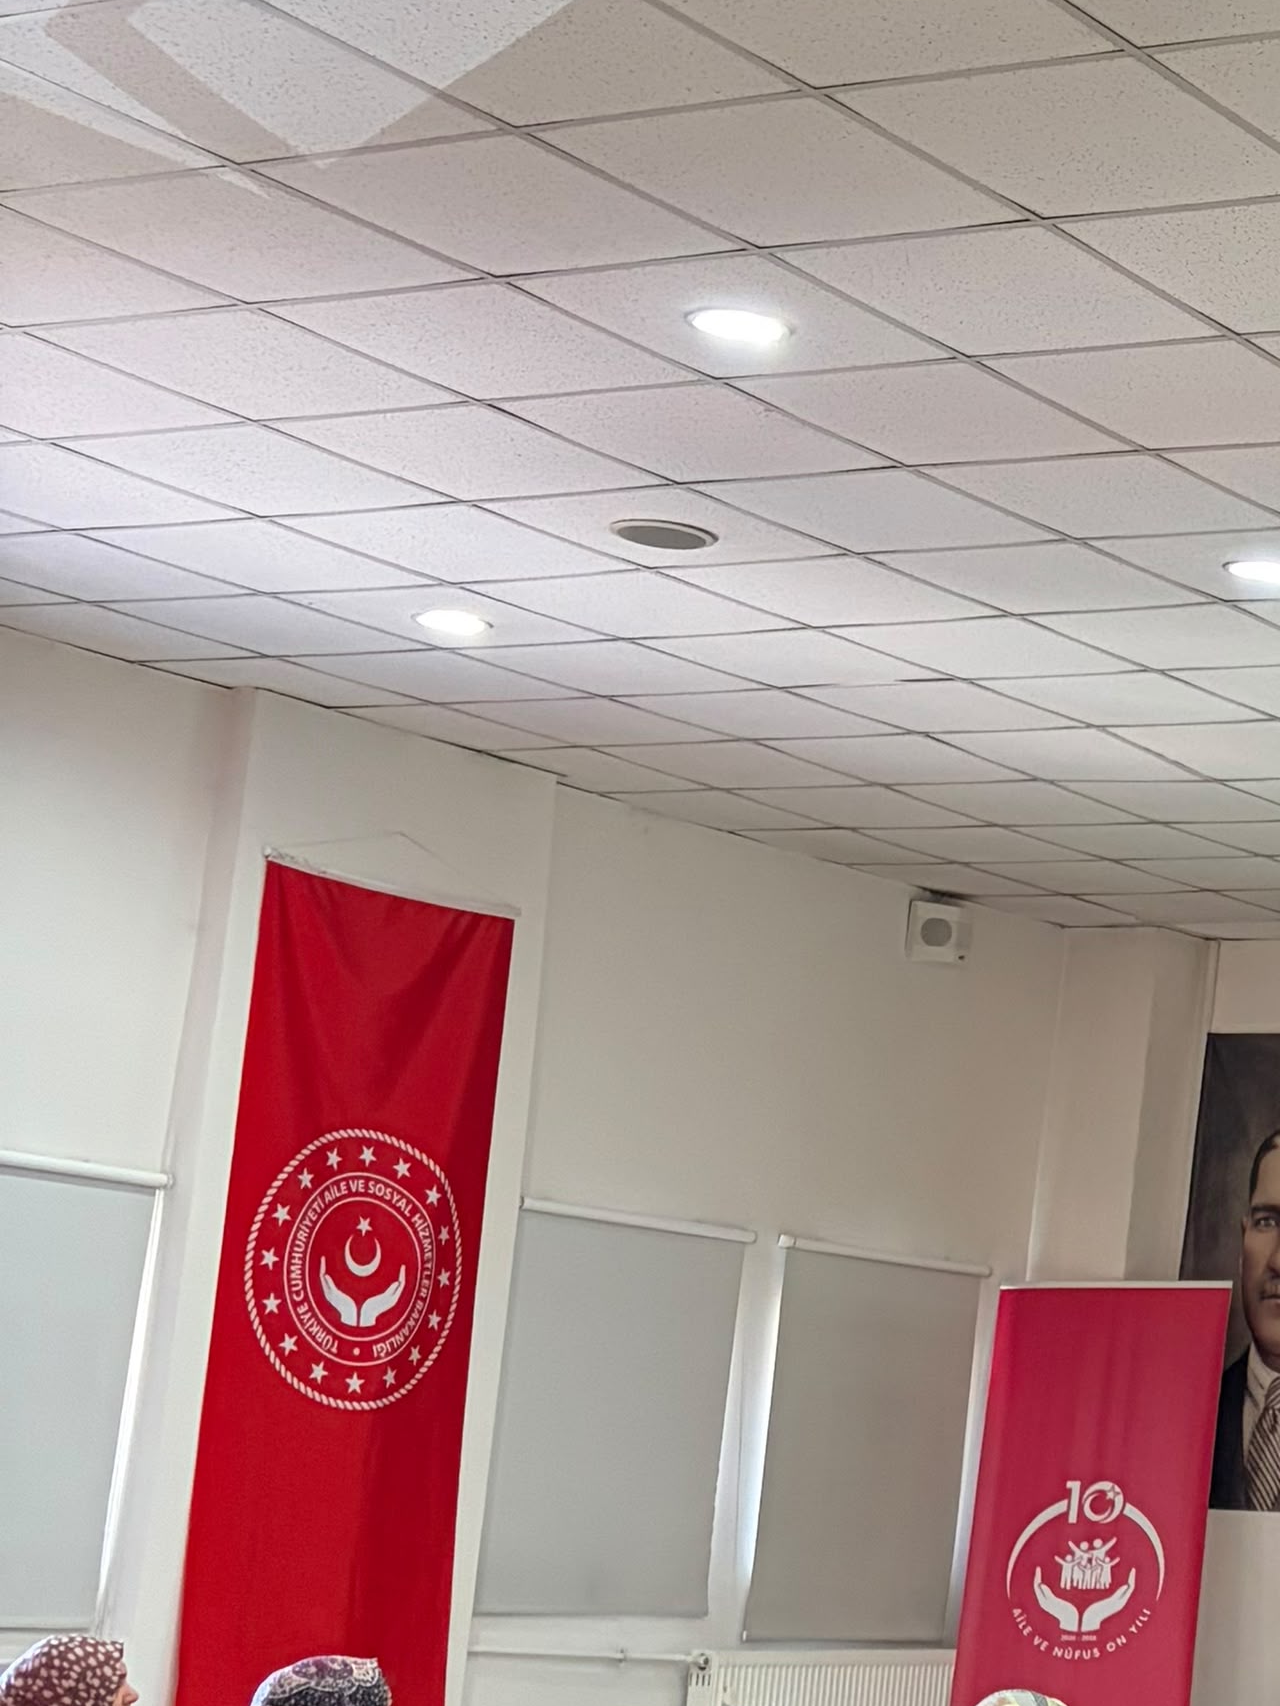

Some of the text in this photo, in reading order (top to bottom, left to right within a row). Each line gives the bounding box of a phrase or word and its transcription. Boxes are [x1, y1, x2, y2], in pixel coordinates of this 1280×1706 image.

[324, 1181, 348, 1204] AİLE
[349, 1179, 365, 1192] VE
[367, 1180, 411, 1217] SOSYAL
[290, 1197, 325, 1301] CUMHURİYETİ
[299, 1303, 339, 1354] TÜRKİYE
[1012, 1608, 1033, 1637] AİLE
[1033, 1636, 1049, 1652] VE
[1053, 1646, 1100, 1660] NÜFUS
[1106, 1635, 1127, 1652] ON
[1129, 1608, 1151, 1634] YILI
